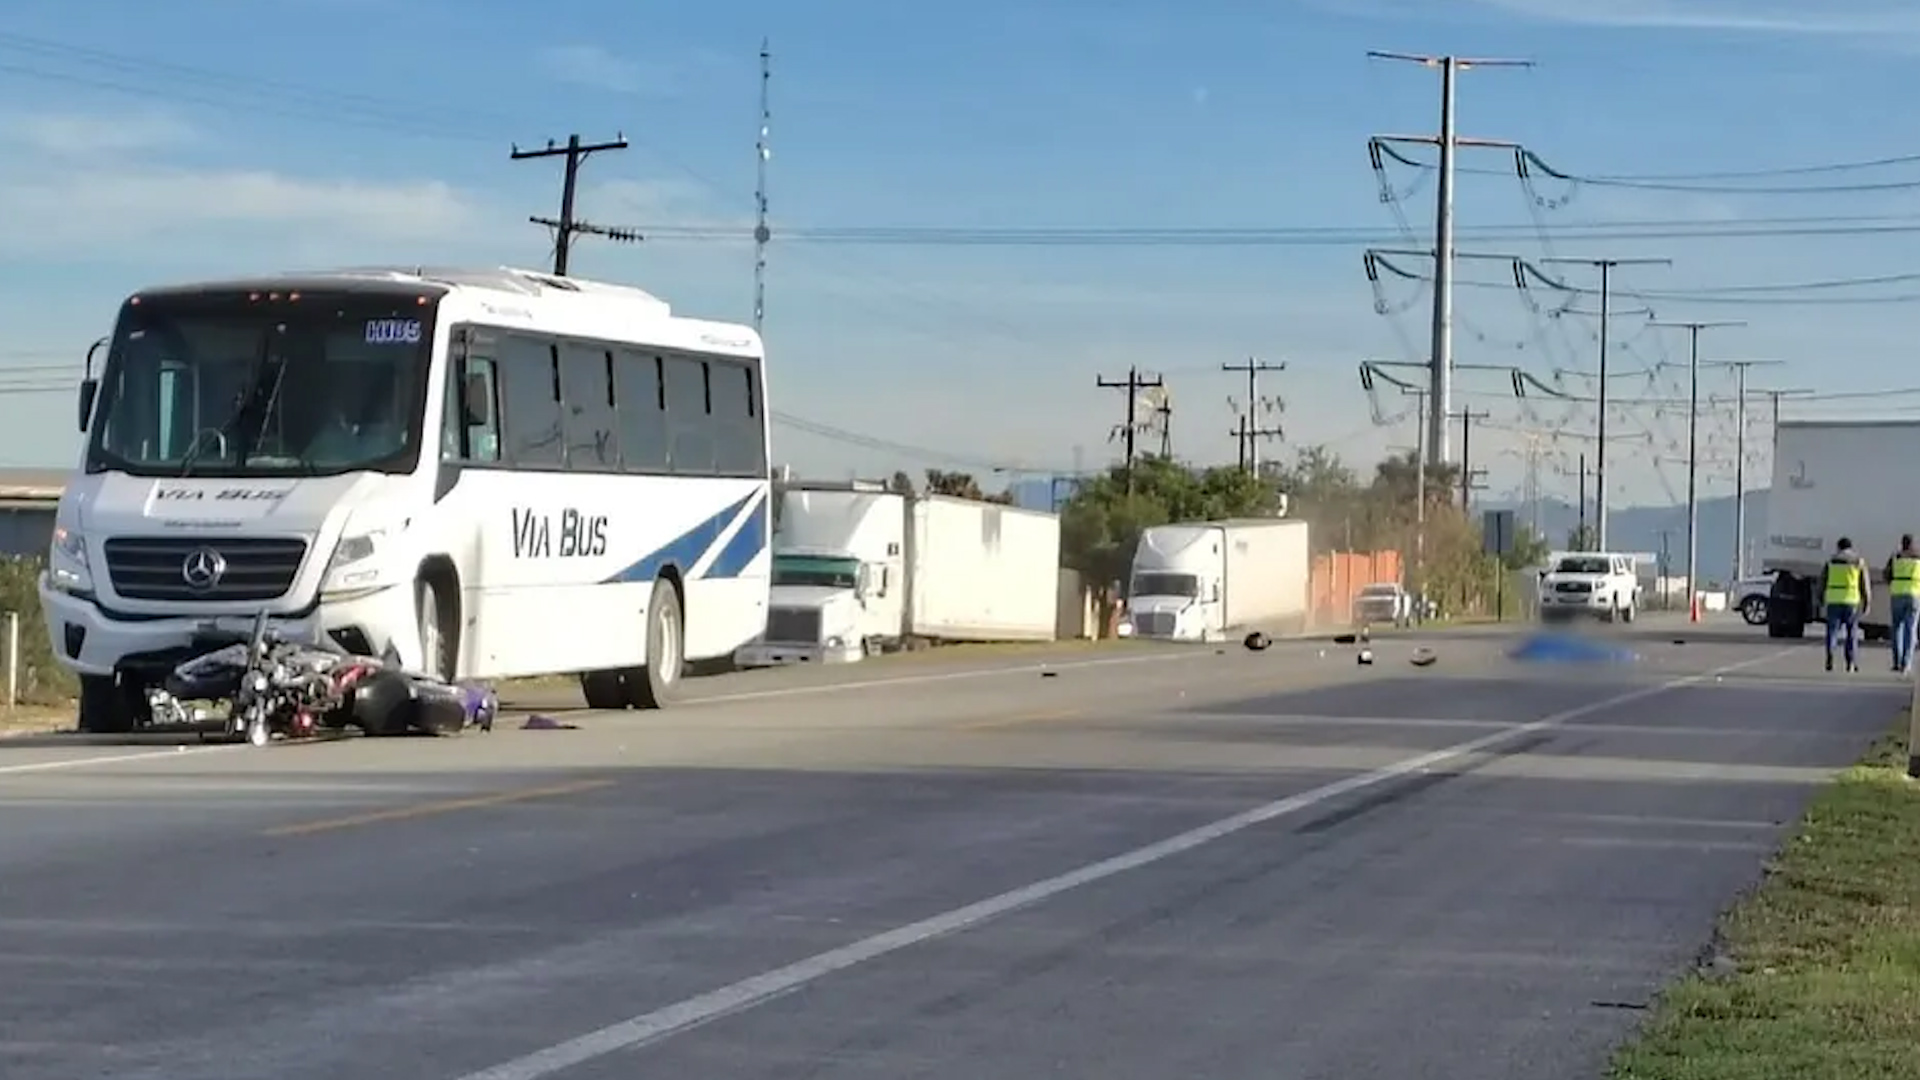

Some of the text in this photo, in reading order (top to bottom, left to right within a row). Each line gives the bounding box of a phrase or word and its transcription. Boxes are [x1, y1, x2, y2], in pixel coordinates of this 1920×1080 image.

[157, 488, 288, 500] VIA BUS
[512, 507, 607, 558] VIA BUS
